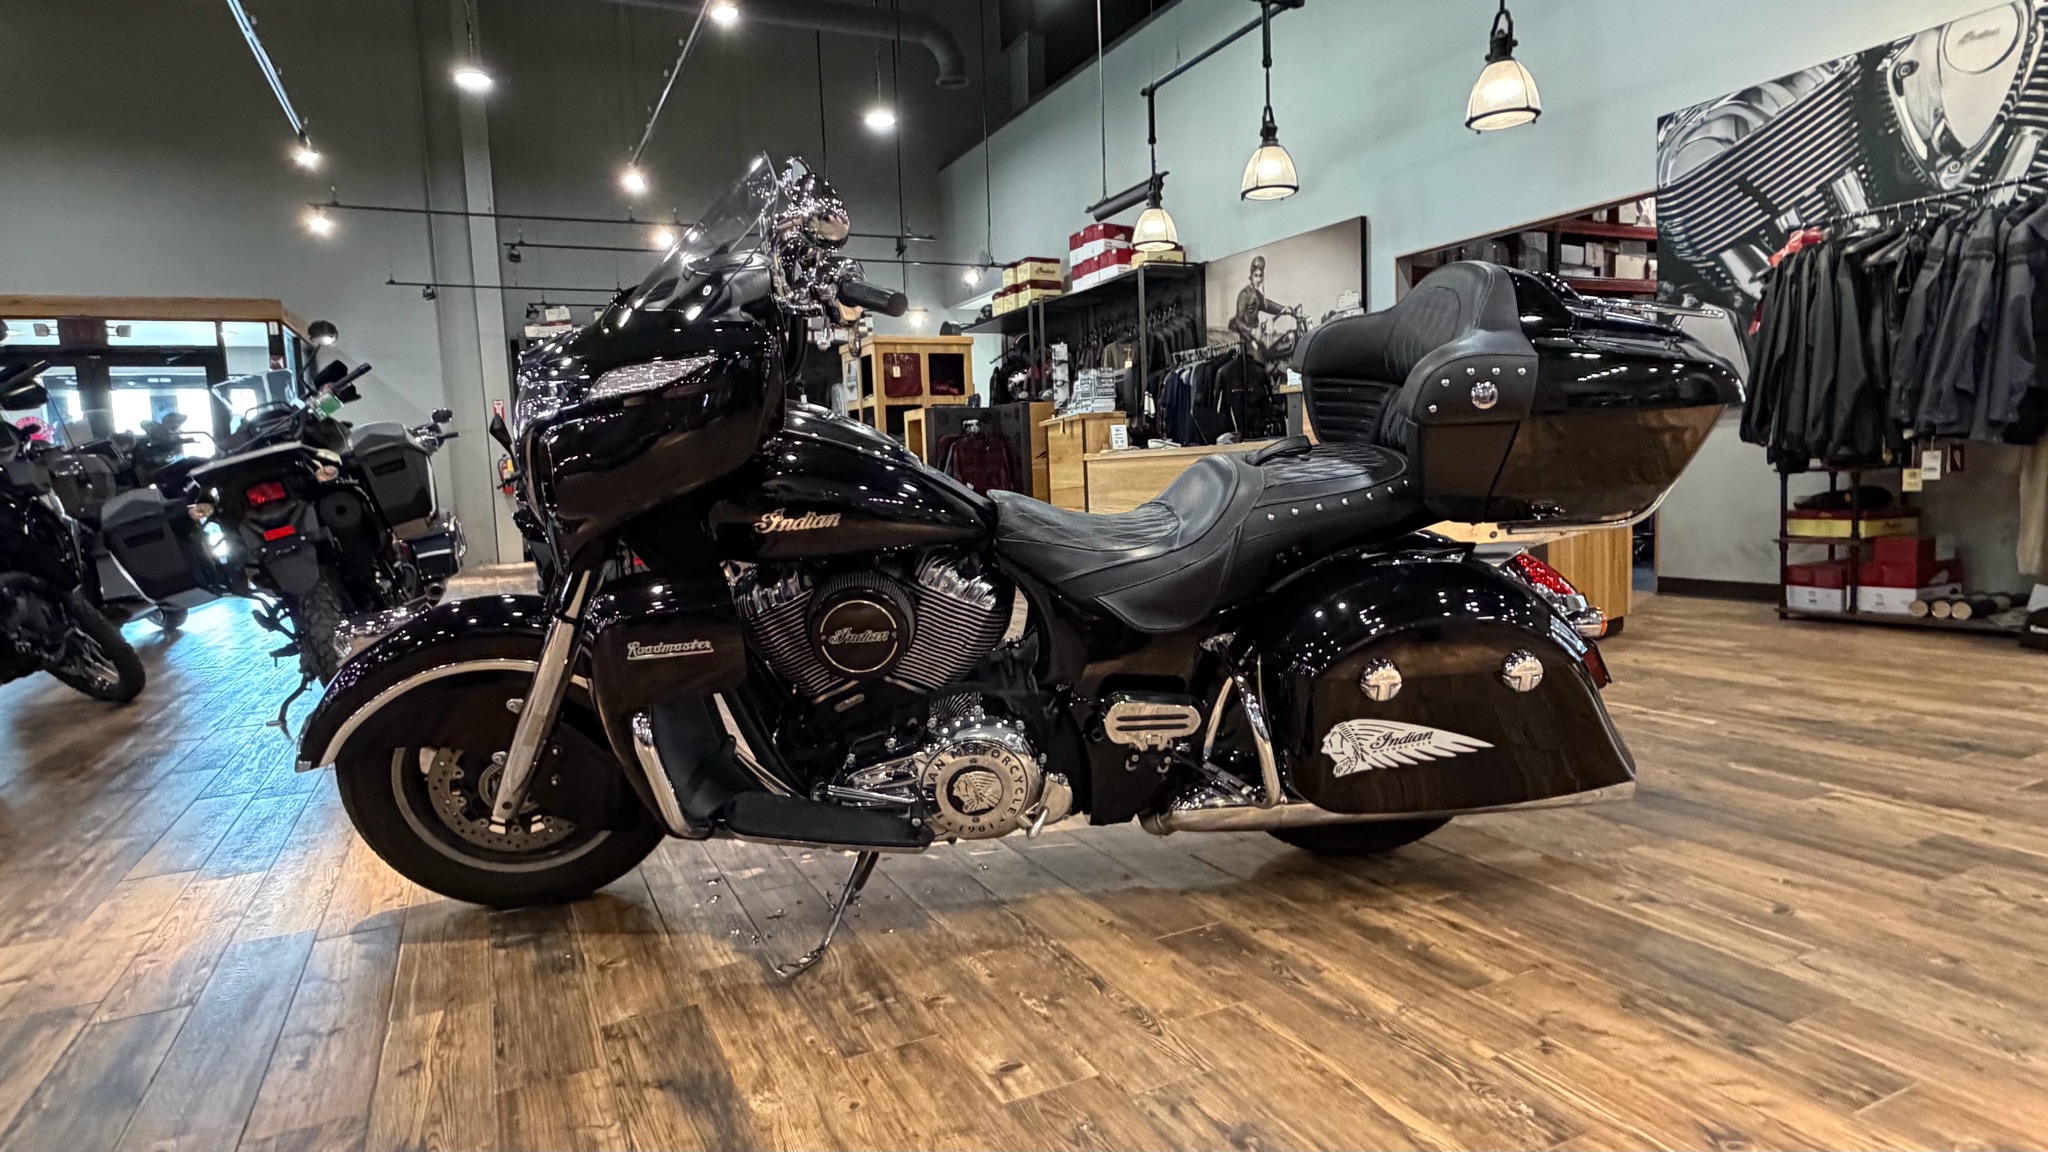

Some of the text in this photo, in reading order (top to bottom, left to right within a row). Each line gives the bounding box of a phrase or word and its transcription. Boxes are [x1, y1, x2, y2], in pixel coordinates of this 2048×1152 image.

[753, 507, 841, 534] Indian
[828, 627, 890, 645] Indian
[627, 639, 713, 658] Roadmaster
[1369, 731, 1434, 750] Indian
[1372, 740, 1432, 754] MOTORCYCLE
[950, 744, 1024, 815] MOTORCYCLE
[959, 822, 994, 833] 1901
